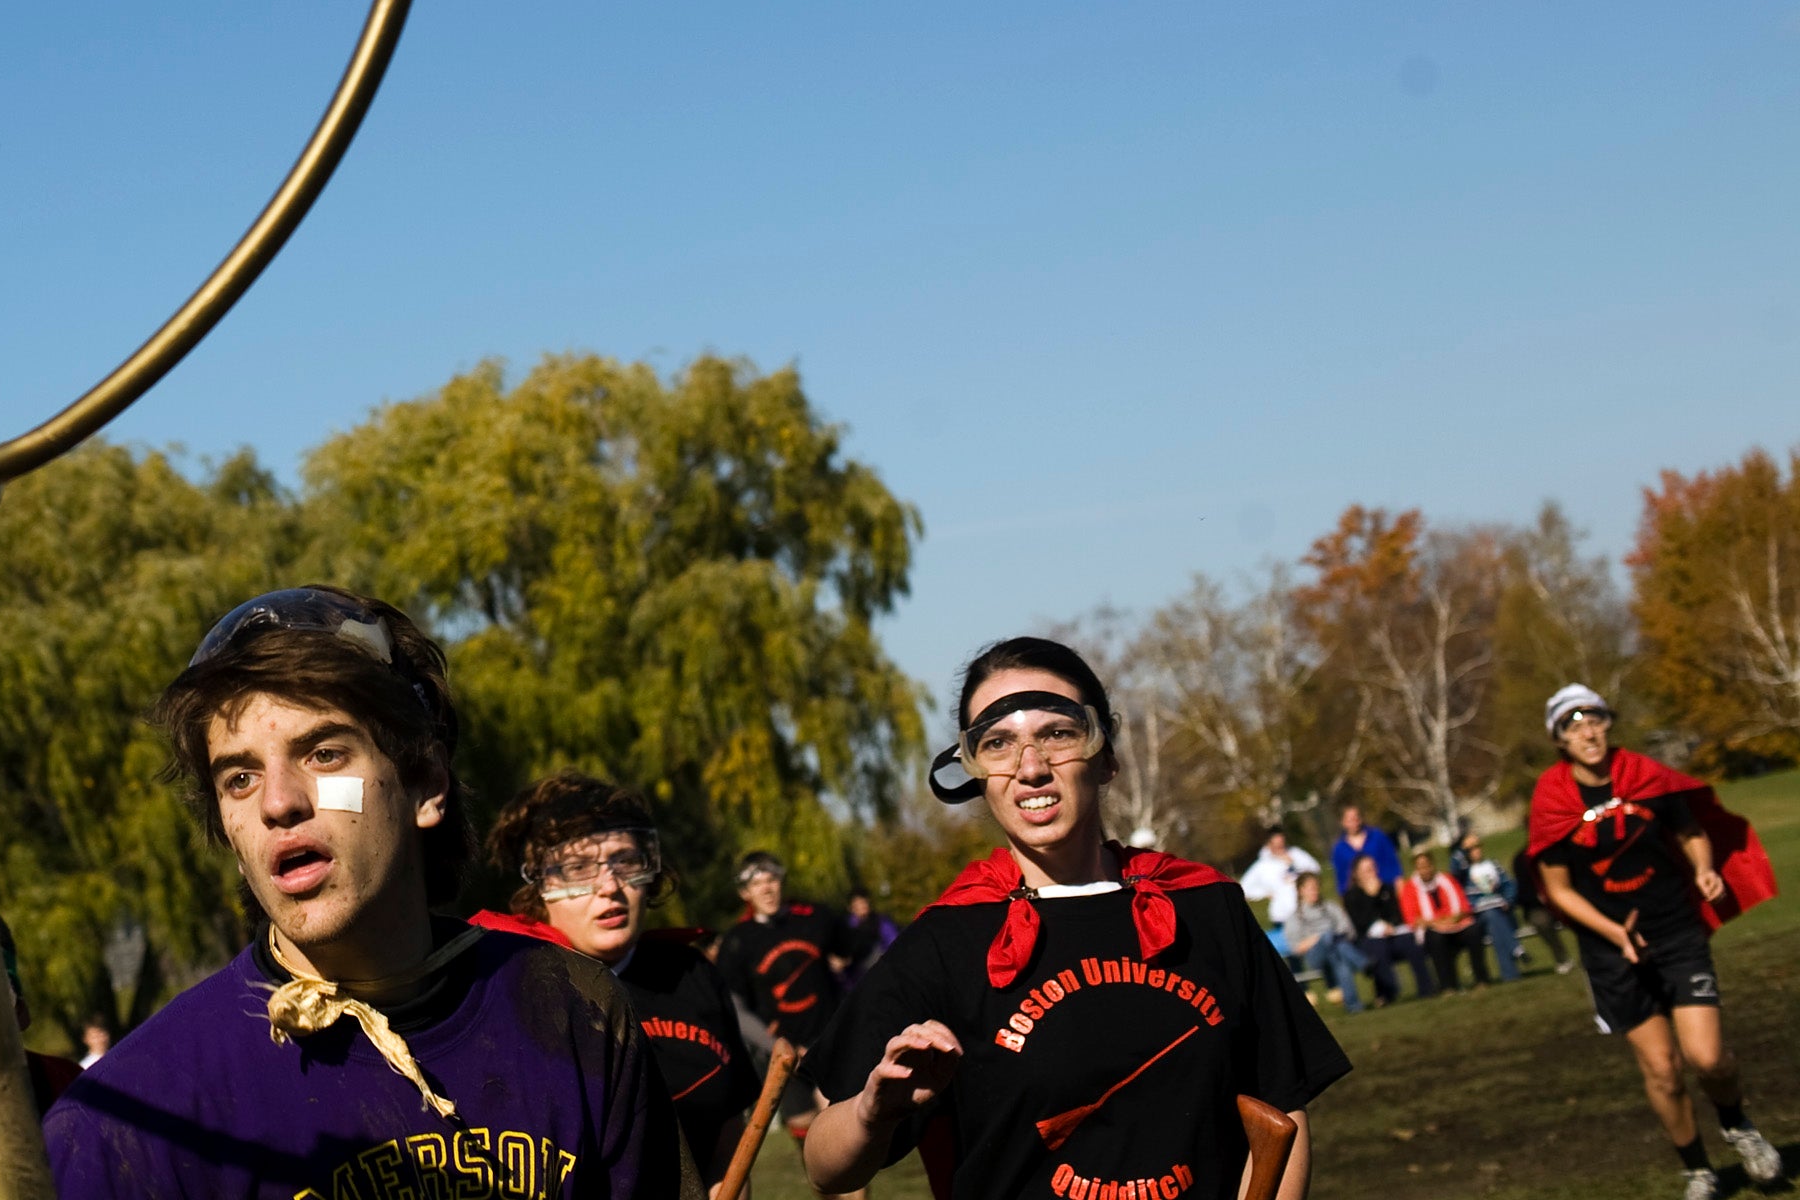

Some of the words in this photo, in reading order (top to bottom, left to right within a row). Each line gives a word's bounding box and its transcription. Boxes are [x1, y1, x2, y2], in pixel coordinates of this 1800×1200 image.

[995, 968, 1081, 1053] Boston
[1080, 956, 1225, 1026] University
[641, 1016, 730, 1065] niversity
[293, 1127, 576, 1200] MERSON
[1051, 1163, 1194, 1200] Quidditch
